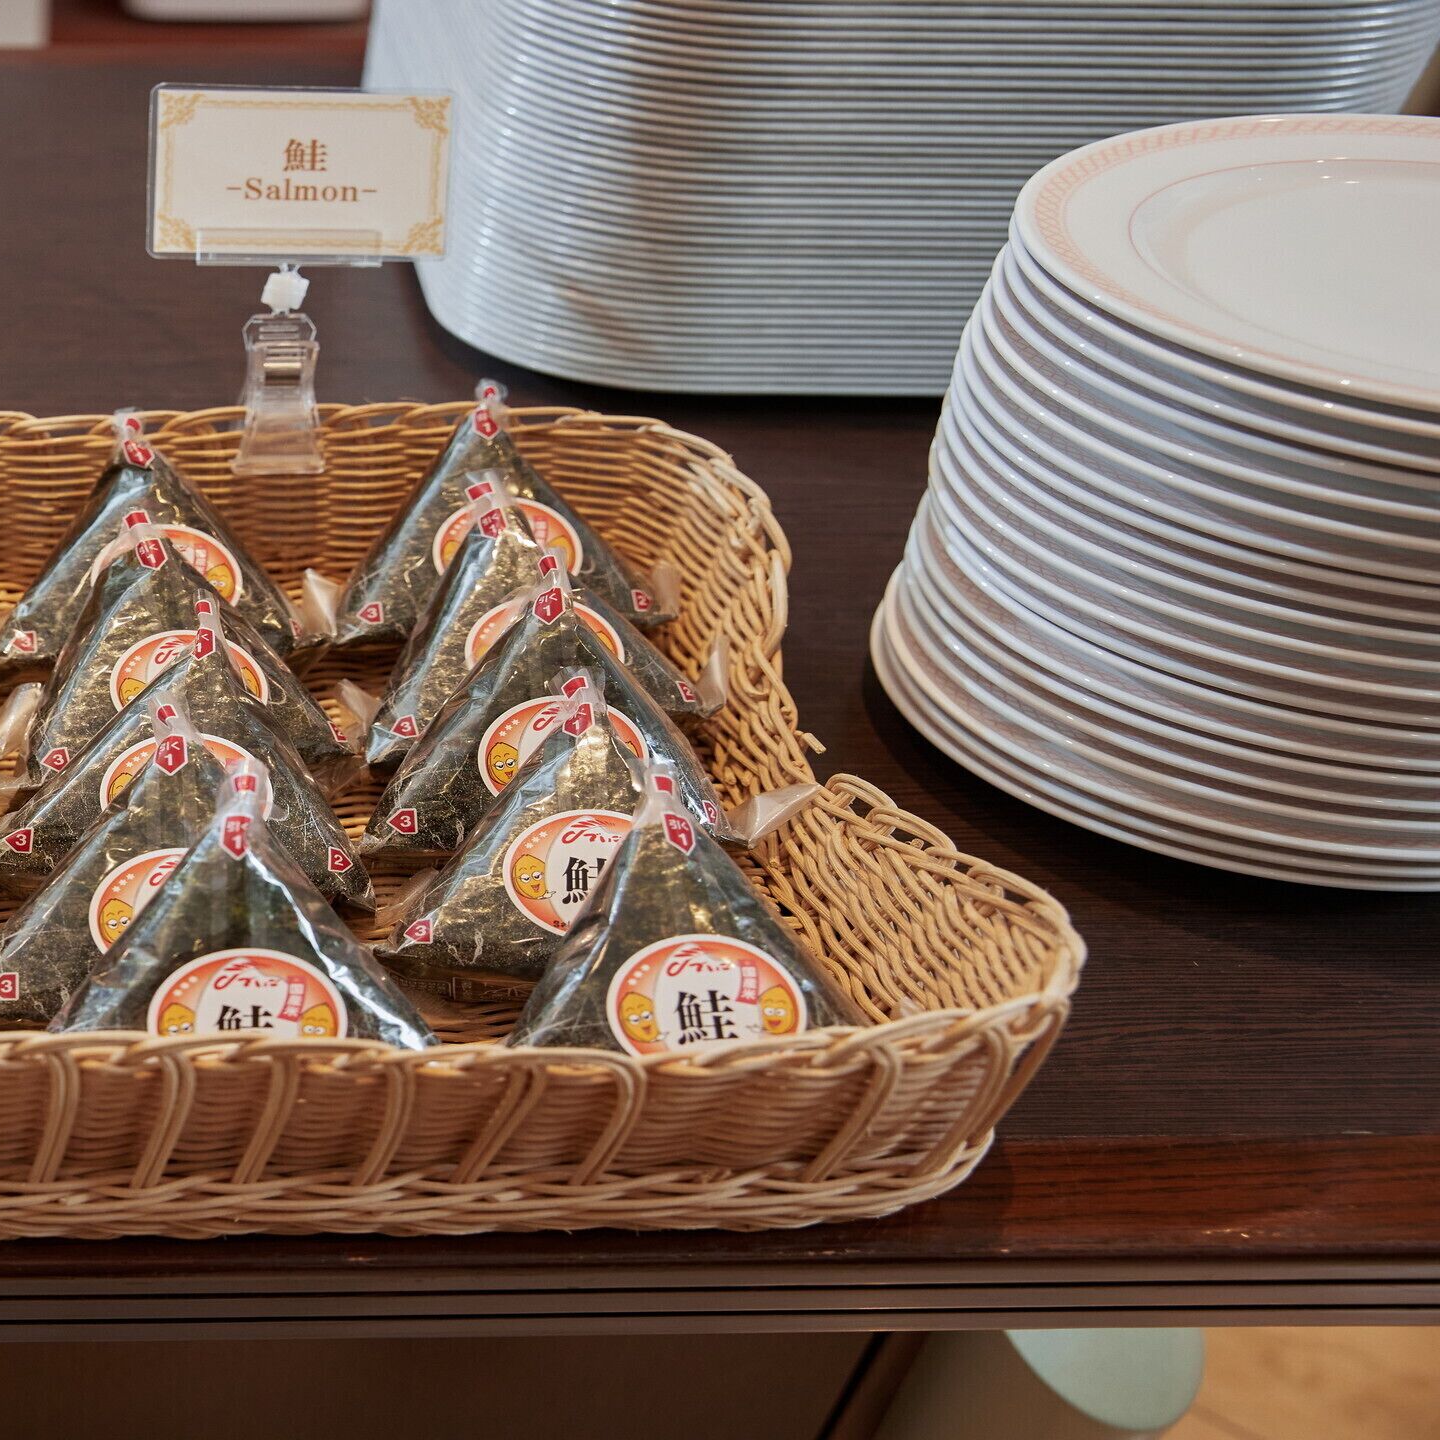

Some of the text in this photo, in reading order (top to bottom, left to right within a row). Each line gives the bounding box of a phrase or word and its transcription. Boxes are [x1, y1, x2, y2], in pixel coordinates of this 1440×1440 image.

[283, 138, 328, 172] 鮭
[147, 554, 156, 564] 1
[539, 593, 558, 604] 引く
[367, 608, 377, 618] 3
[543, 605, 551, 616] 1
[400, 721, 410, 732] 3
[572, 720, 580, 730] 1
[160, 741, 180, 752] 引く
[52, 754, 64, 765] 3
[164, 753, 172, 766] 1
[708, 807, 715, 818] 2
[400, 815, 411, 827] 3
[670, 819, 689, 830] 引く
[15, 834, 27, 846] 3
[232, 835, 242, 849] 1
[678, 833, 687, 846] 1
[334, 854, 343, 866] 2
[414, 925, 426, 937] 3
[0, 980, 12, 993] 3
[674, 990, 739, 1045] 鮭
